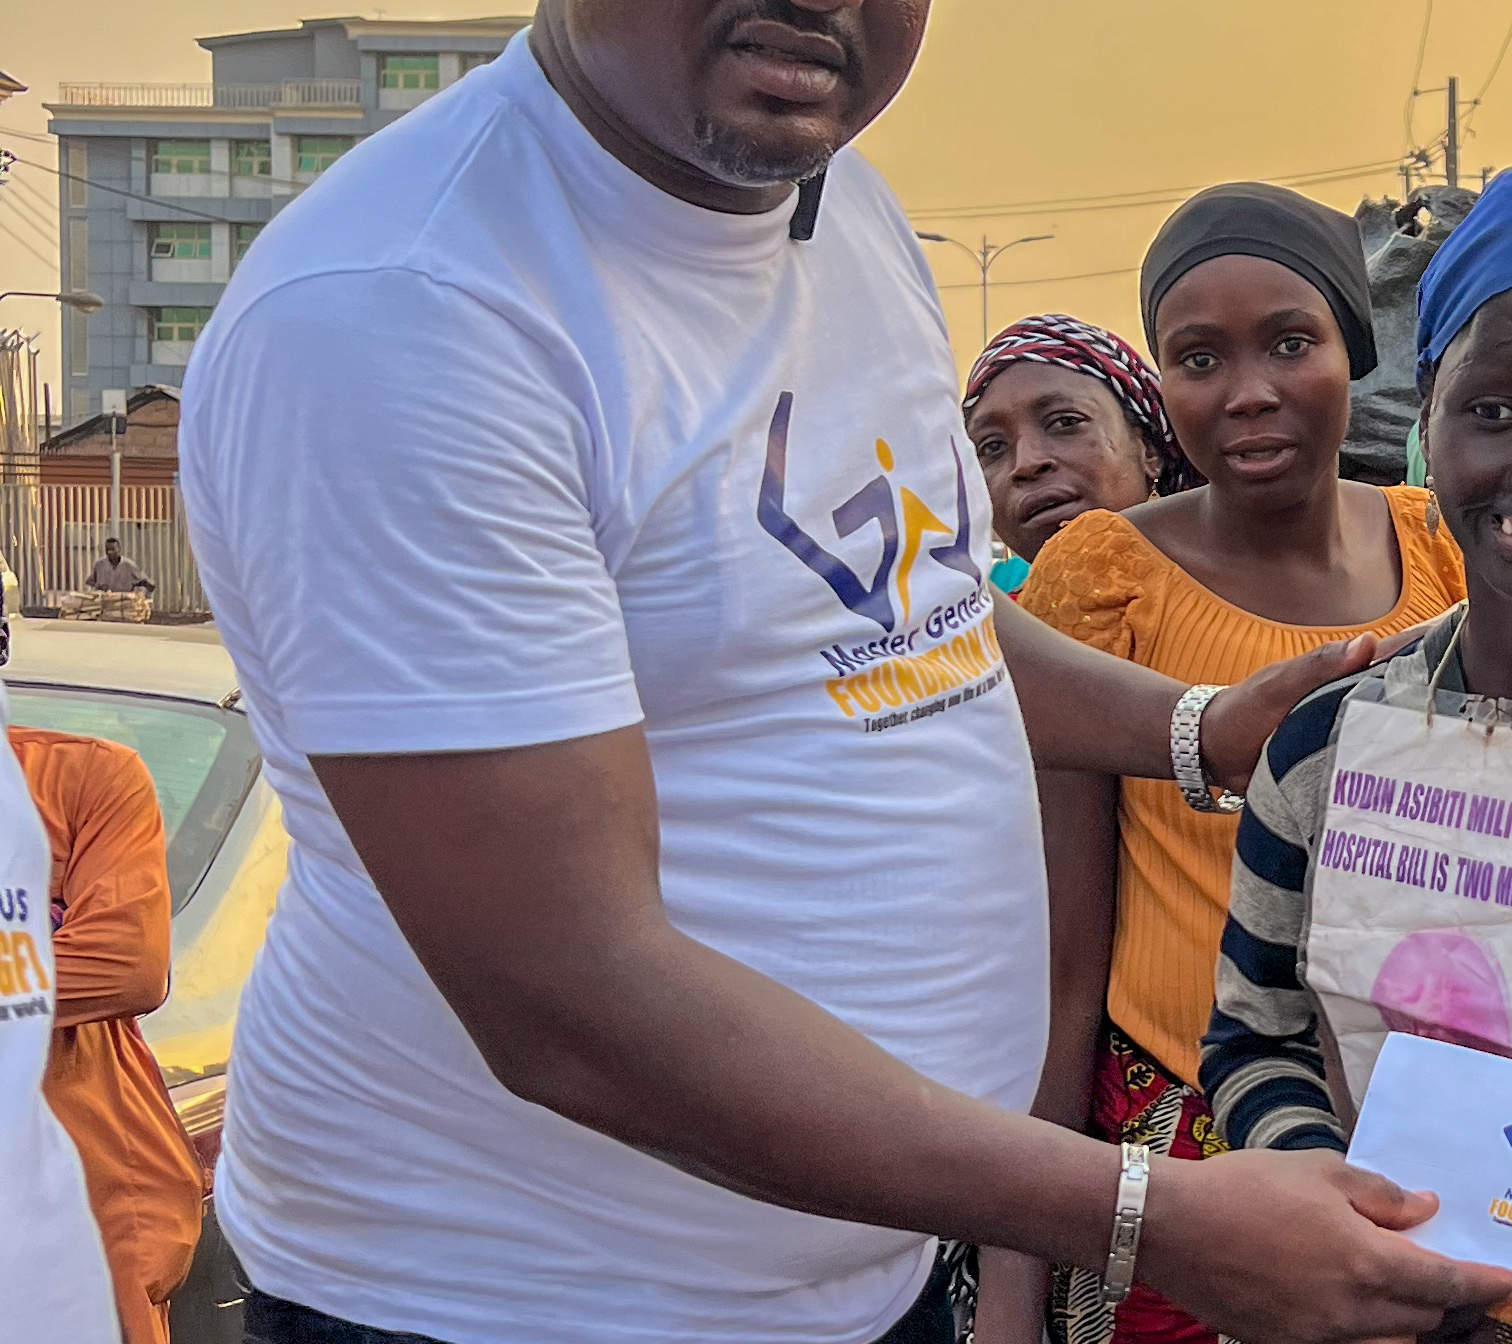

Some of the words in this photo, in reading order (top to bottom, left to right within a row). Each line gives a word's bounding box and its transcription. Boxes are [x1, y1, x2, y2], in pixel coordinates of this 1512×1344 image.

[820, 627, 920, 677] Master
[825, 626, 992, 718] FOUNDATION
[1333, 768, 1397, 814] KUDIN
[1395, 781, 1467, 829] ASIBITI
[1321, 828, 1396, 880] HOSPITAL
[1395, 844, 1429, 888] BILL
[1429, 851, 1450, 893] IS
[1454, 856, 1495, 902] TWO
